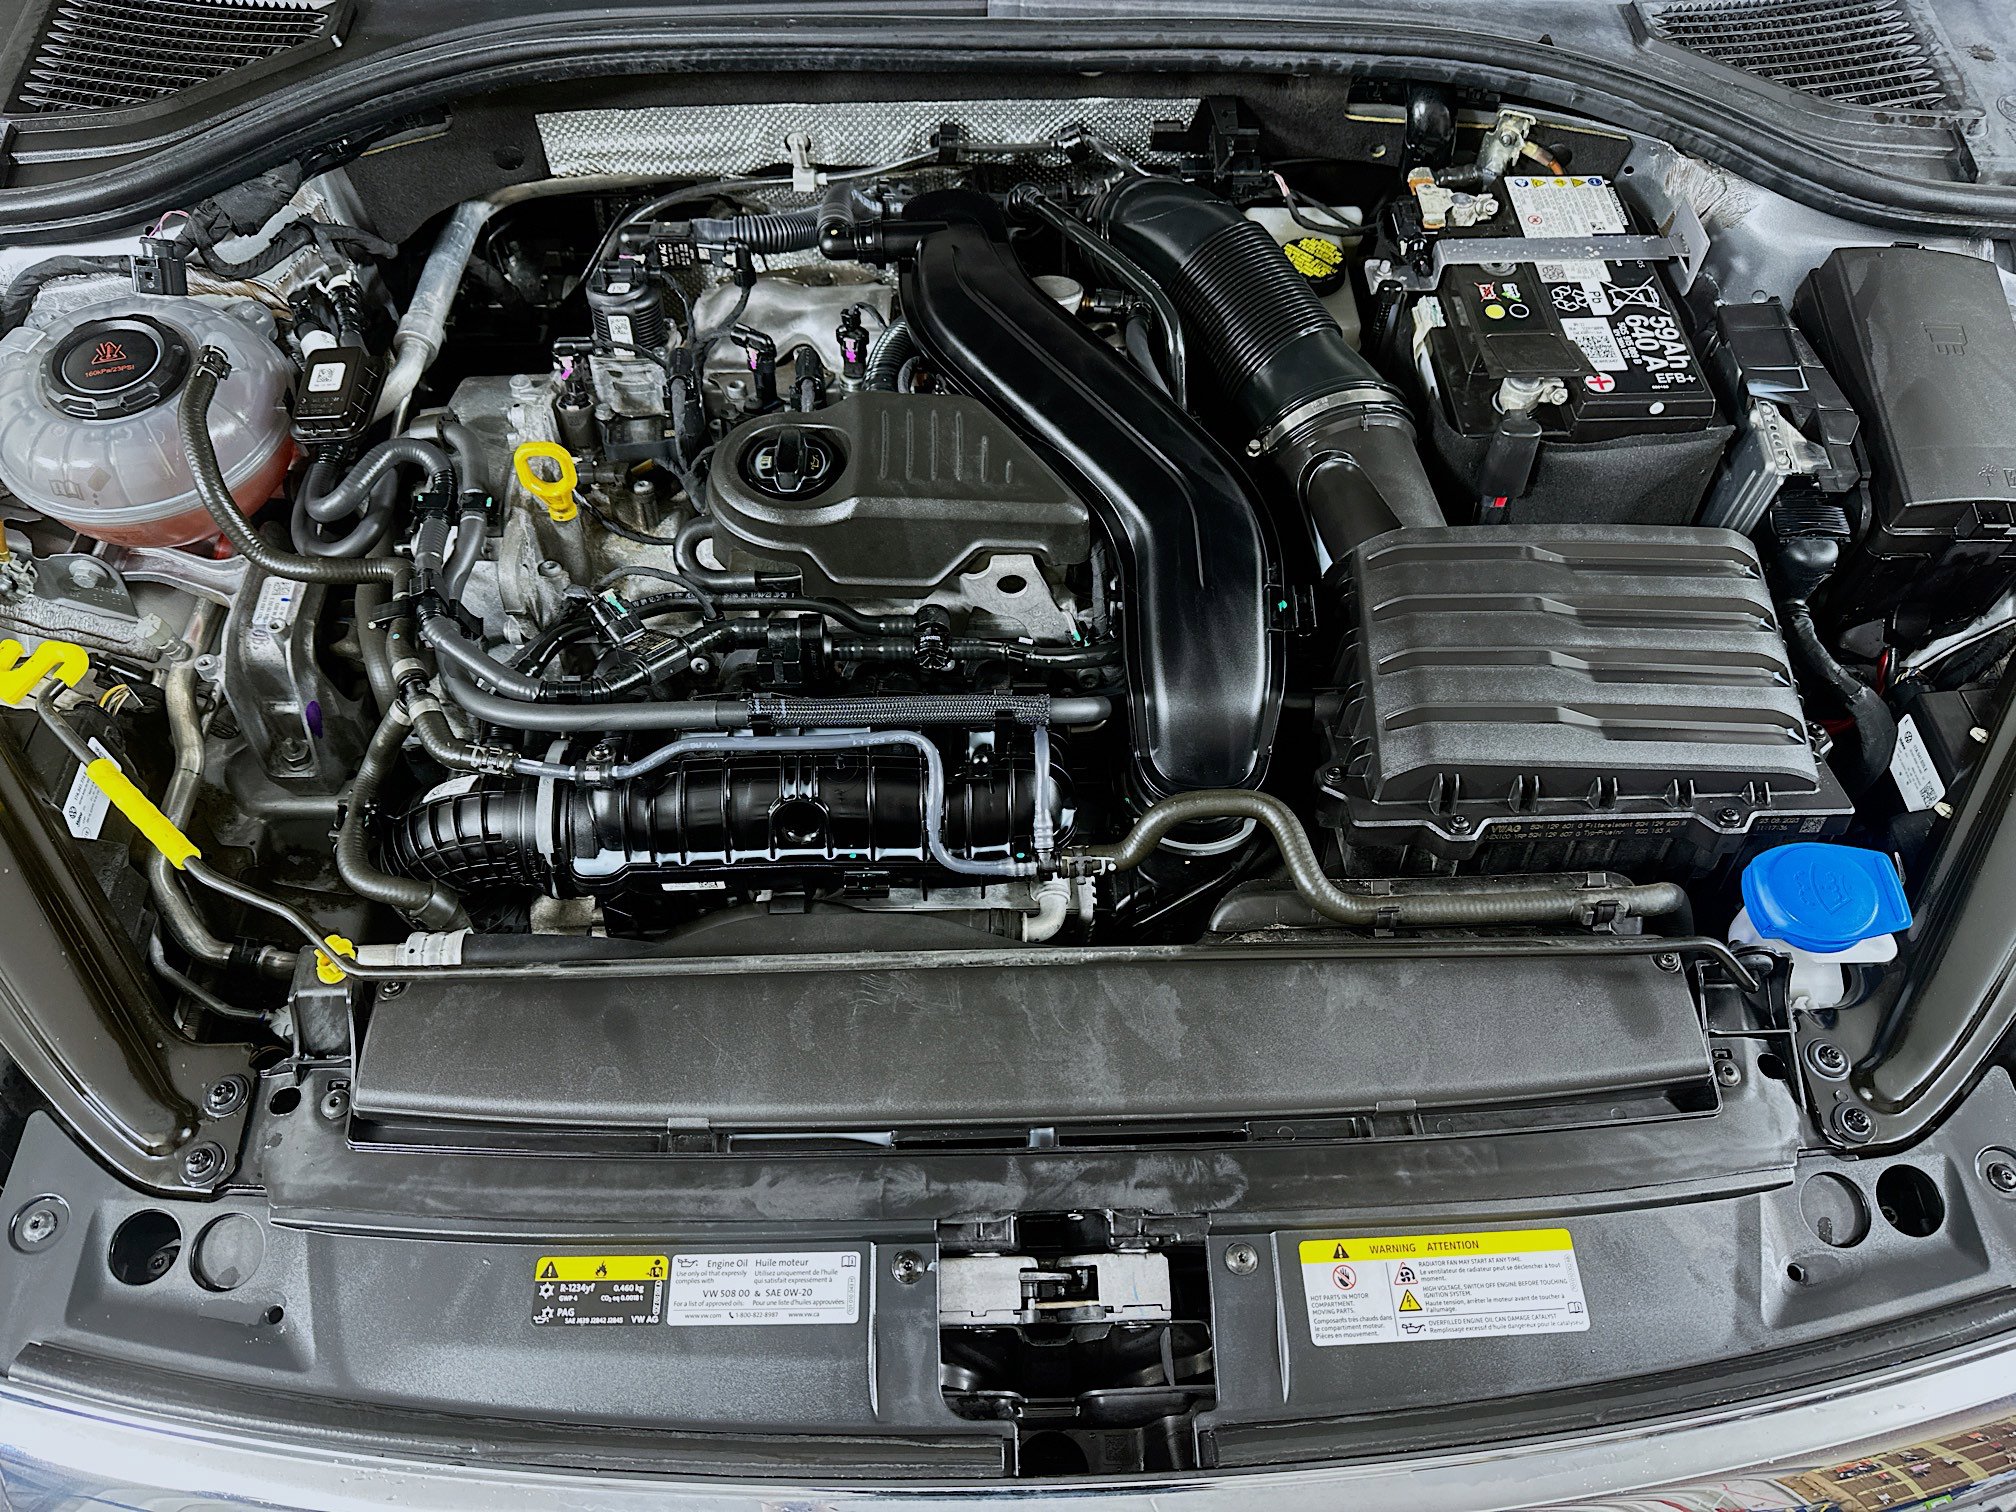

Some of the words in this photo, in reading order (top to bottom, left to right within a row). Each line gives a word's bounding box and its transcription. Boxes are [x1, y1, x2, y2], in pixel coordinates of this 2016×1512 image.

[1589, 291, 1601, 304] Pb
[1625, 314, 1660, 350] 640
[1650, 316, 1692, 368] 59Ah
[1641, 355, 1669, 372] A
[1655, 372, 1696, 384] EFB+
[1369, 1243, 1416, 1254] WARNING
[1427, 1240, 1479, 1251] ATTENTION
[707, 1260, 734, 1269] Engine
[560, 1283, 596, 1294] R-1234yf
[635, 1284, 644, 1293] kg
[766, 1289, 781, 1297] SAE
[557, 1308, 575, 1317] PAG
